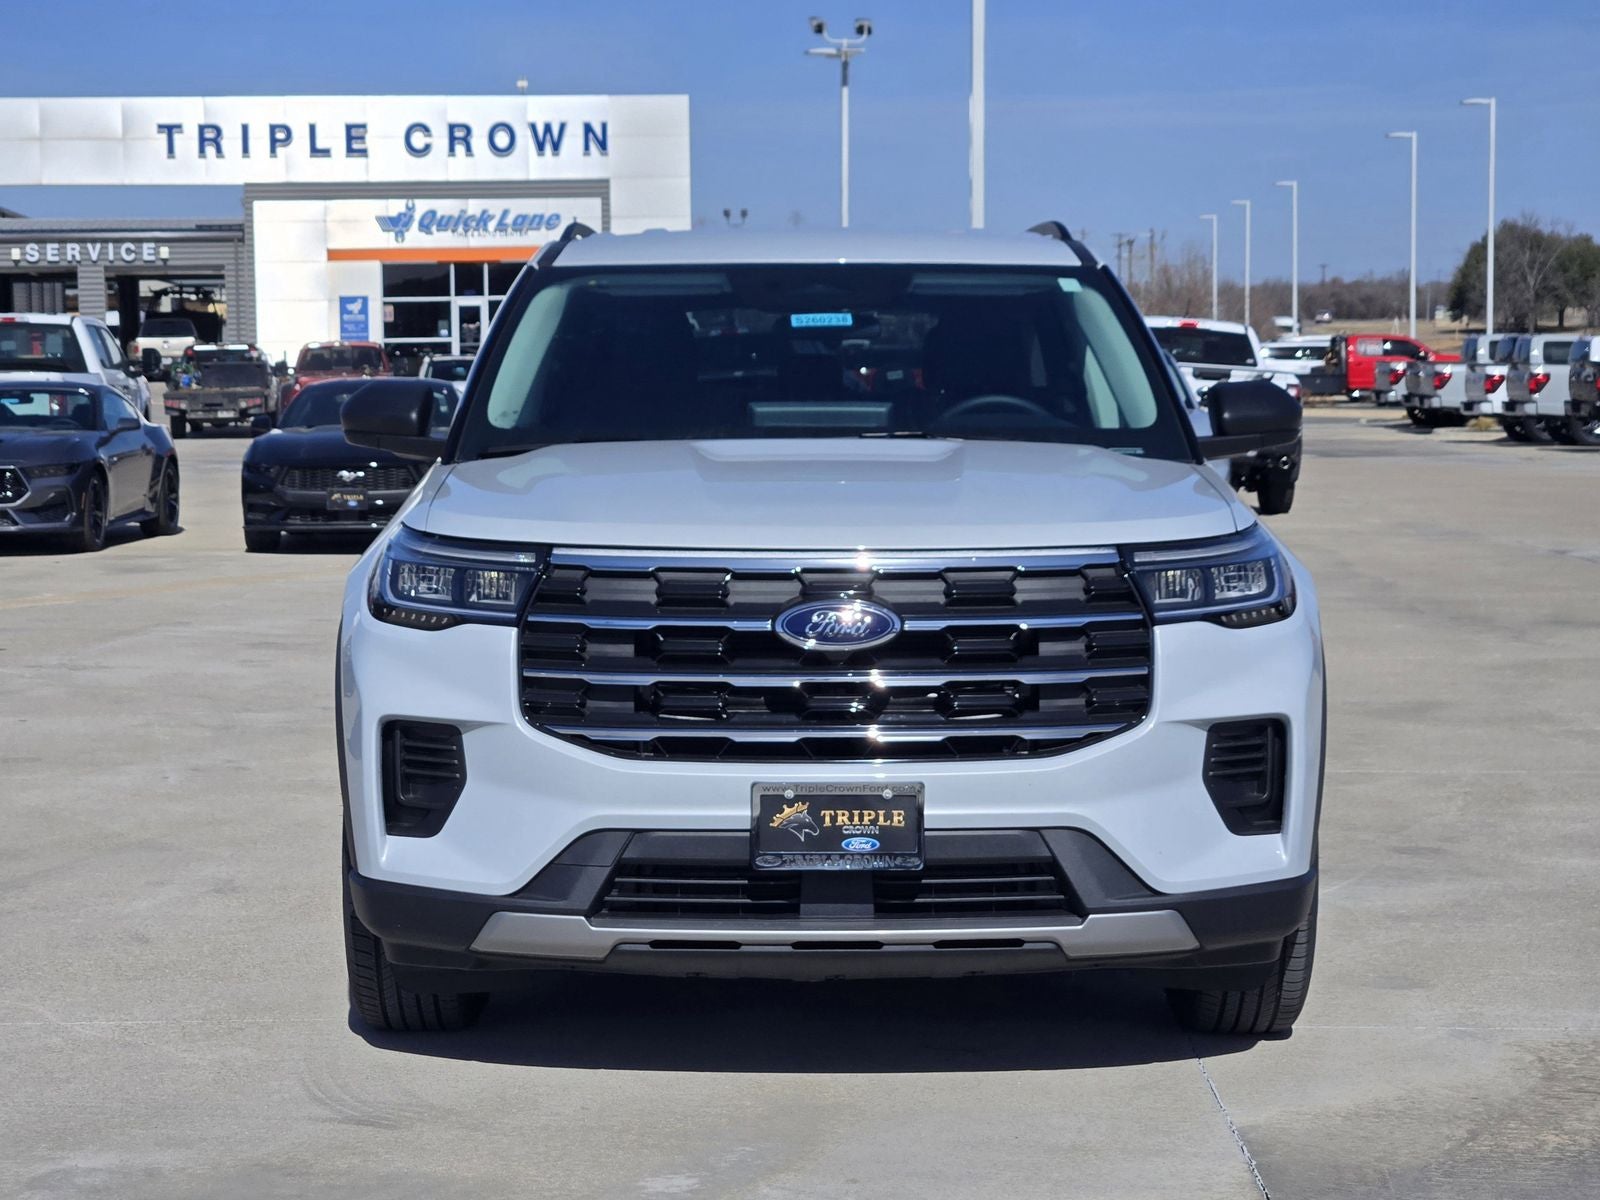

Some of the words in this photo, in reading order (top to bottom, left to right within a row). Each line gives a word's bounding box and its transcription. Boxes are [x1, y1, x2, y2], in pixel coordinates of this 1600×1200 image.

[157, 123, 368, 159] TRIPLE
[404, 121, 609, 158] CROWN
[418, 209, 494, 235] Quick
[496, 209, 561, 231] Lane
[25, 242, 156, 263] SERVICE
[805, 610, 871, 637] Ford
[762, 783, 917, 794] wwwTripleCrownFordcom
[820, 810, 905, 827] TRIPLE
[842, 826, 879, 834] CROWN
[848, 839, 872, 849] Ford
[844, 855, 895, 868] CROWN
